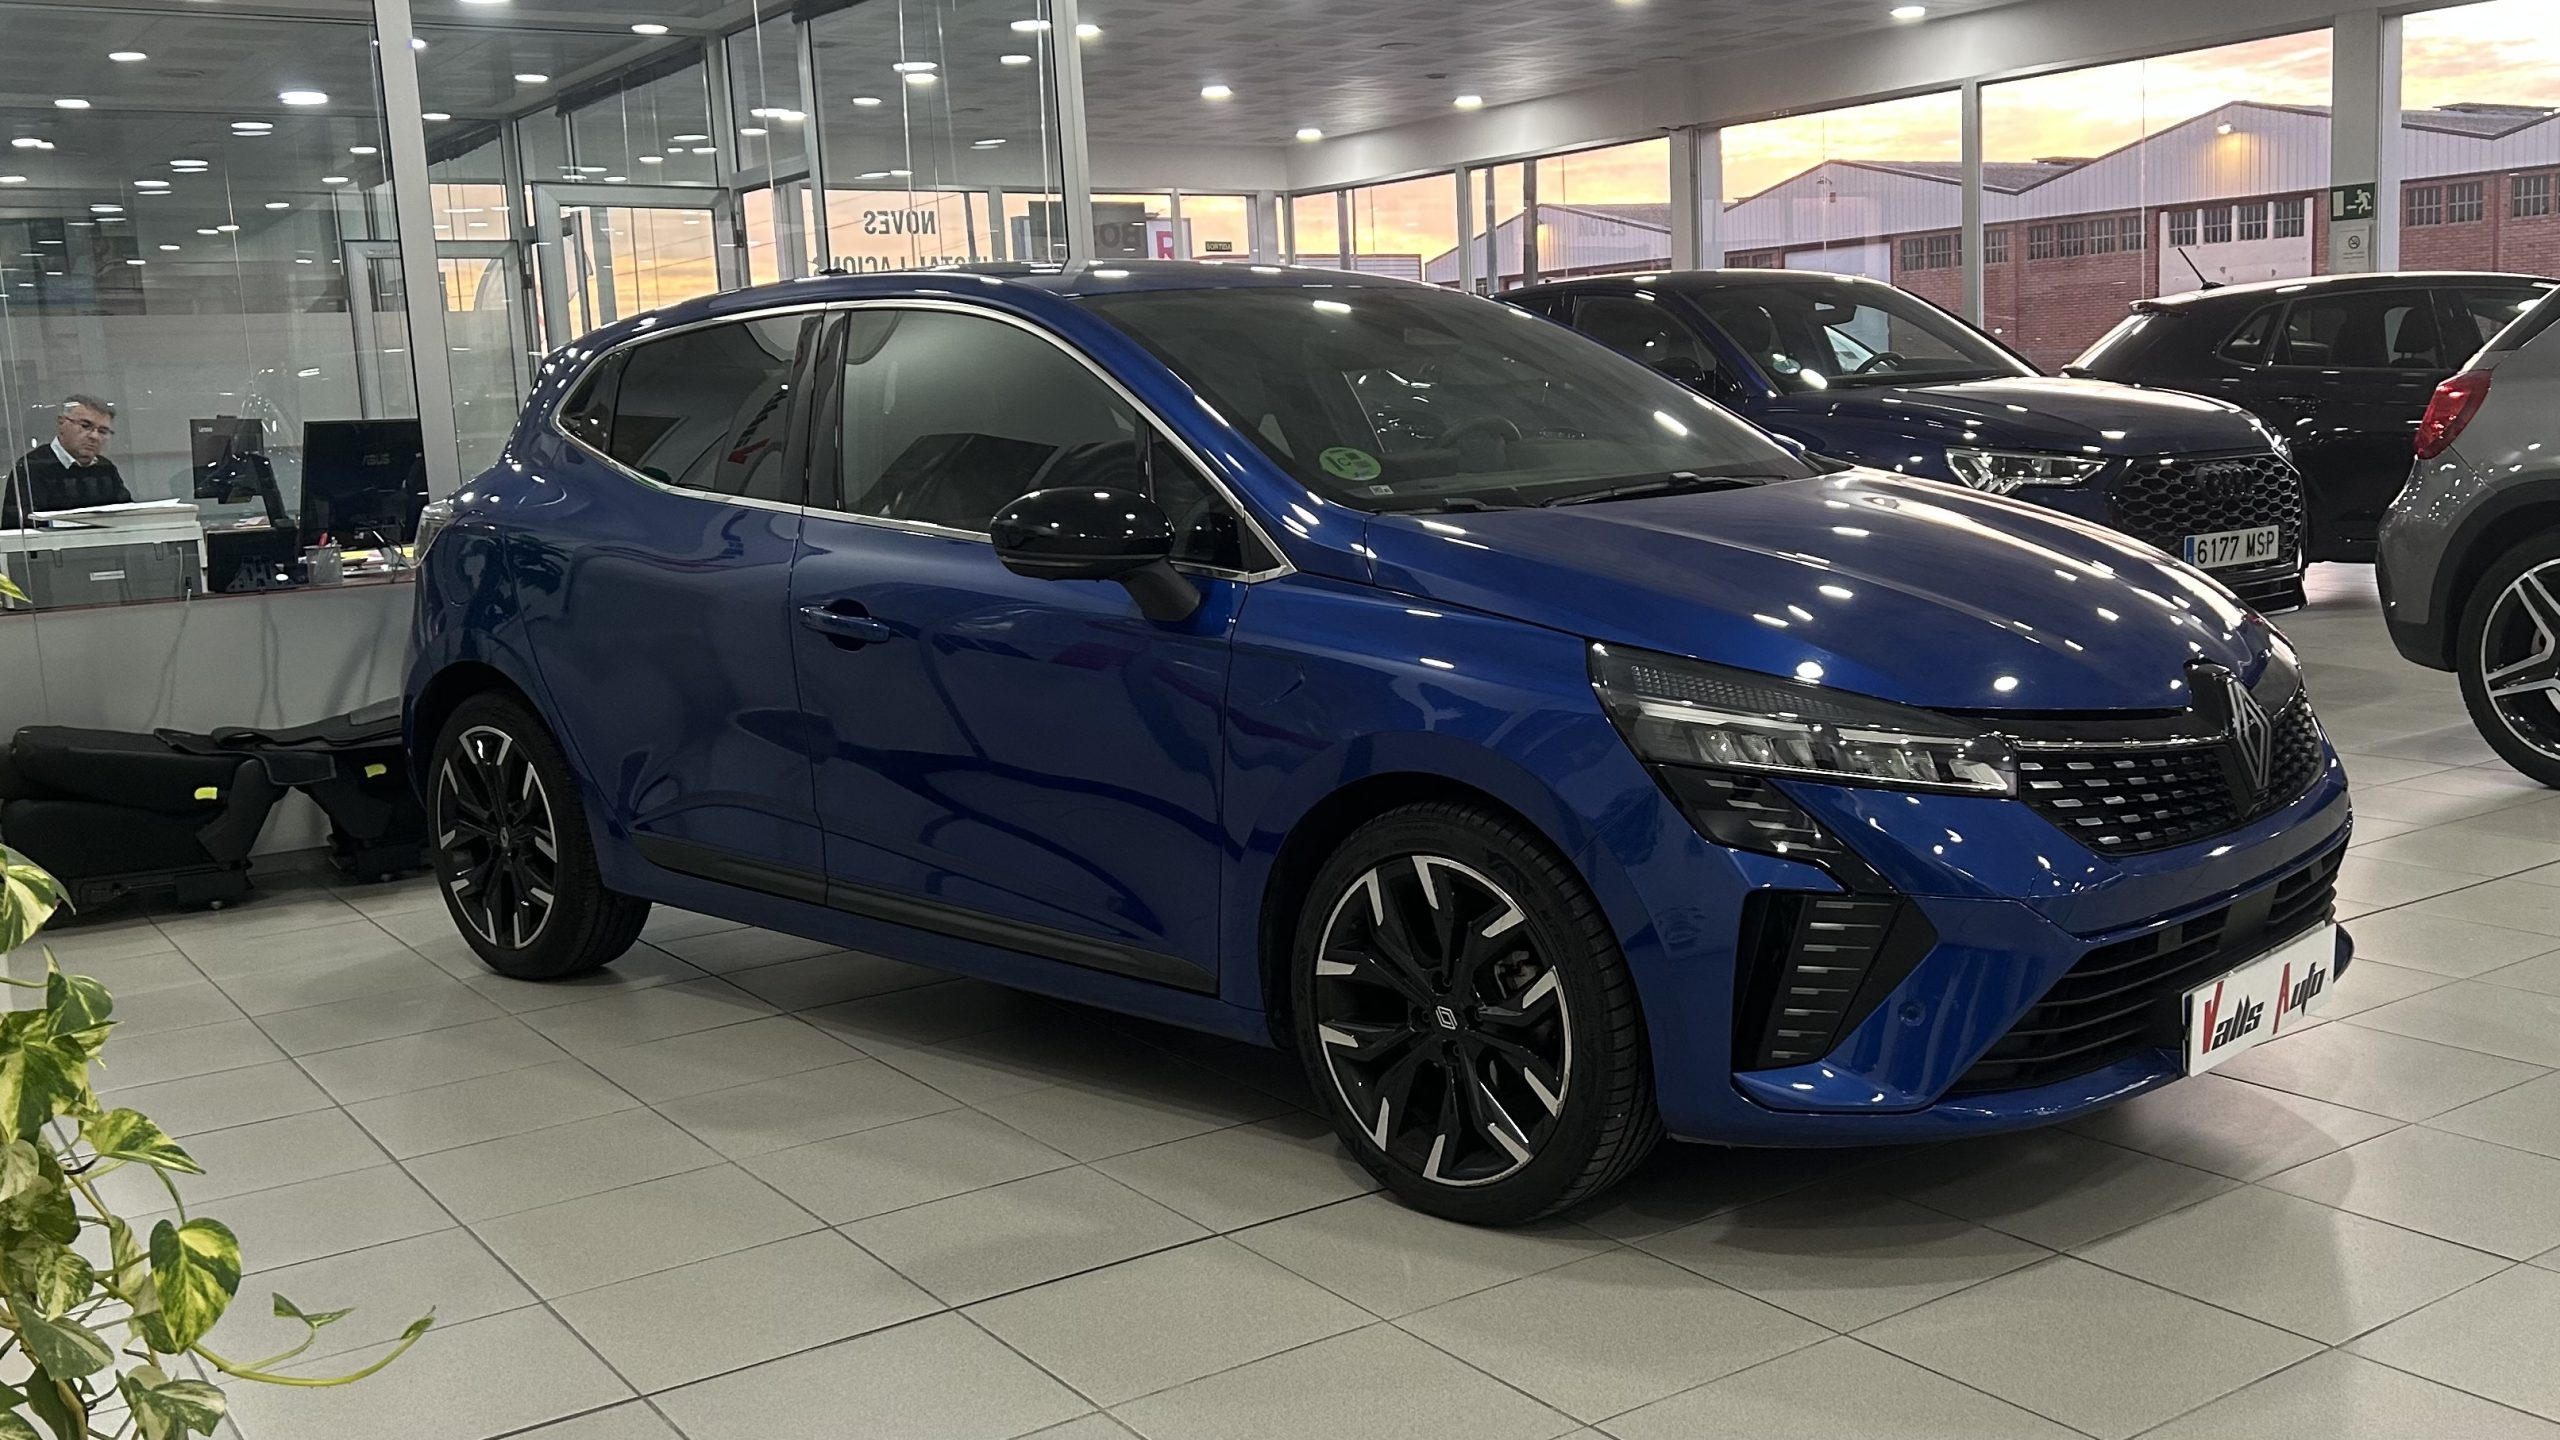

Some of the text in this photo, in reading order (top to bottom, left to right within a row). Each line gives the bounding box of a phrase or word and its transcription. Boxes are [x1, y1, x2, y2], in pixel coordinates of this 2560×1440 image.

[361, 453, 391, 466] ASUS
[2197, 531, 2275, 564] 6177 MSP
[2202, 961, 2326, 1055] Valls Auto
